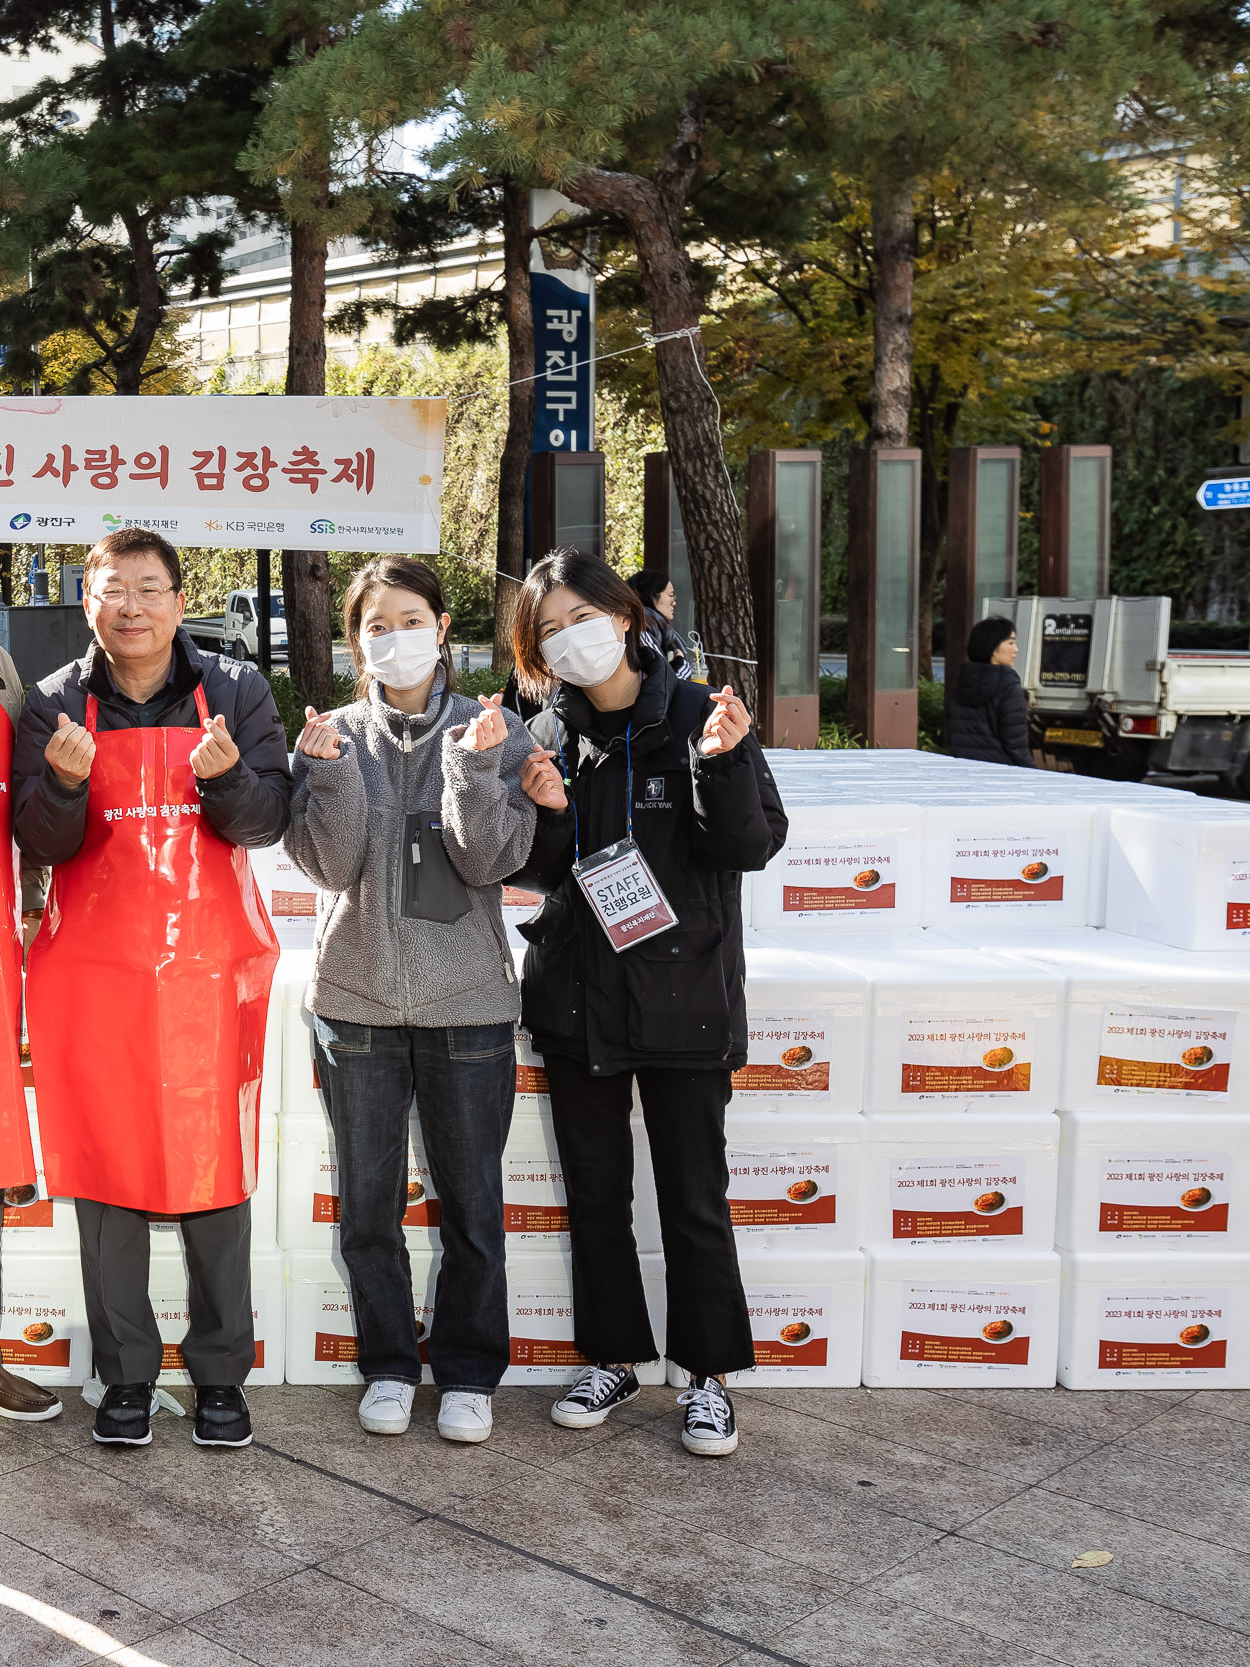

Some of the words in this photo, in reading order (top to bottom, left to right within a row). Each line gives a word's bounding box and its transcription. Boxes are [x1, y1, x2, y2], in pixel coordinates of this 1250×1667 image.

[32, 443, 170, 491] 사랑의
[189, 444, 375, 496] 김장축제
[35, 517, 76, 527] 광진구
[124, 519, 178, 530] 광진복지재단
[337, 525, 404, 536] 한국사회보장정보원
[104, 808, 123, 821] 광진
[125, 805, 157, 819] 사랑의
[160, 804, 201, 817] 김장축제
[597, 872, 642, 903] STAFF
[601, 885, 653, 917] 진행요원
